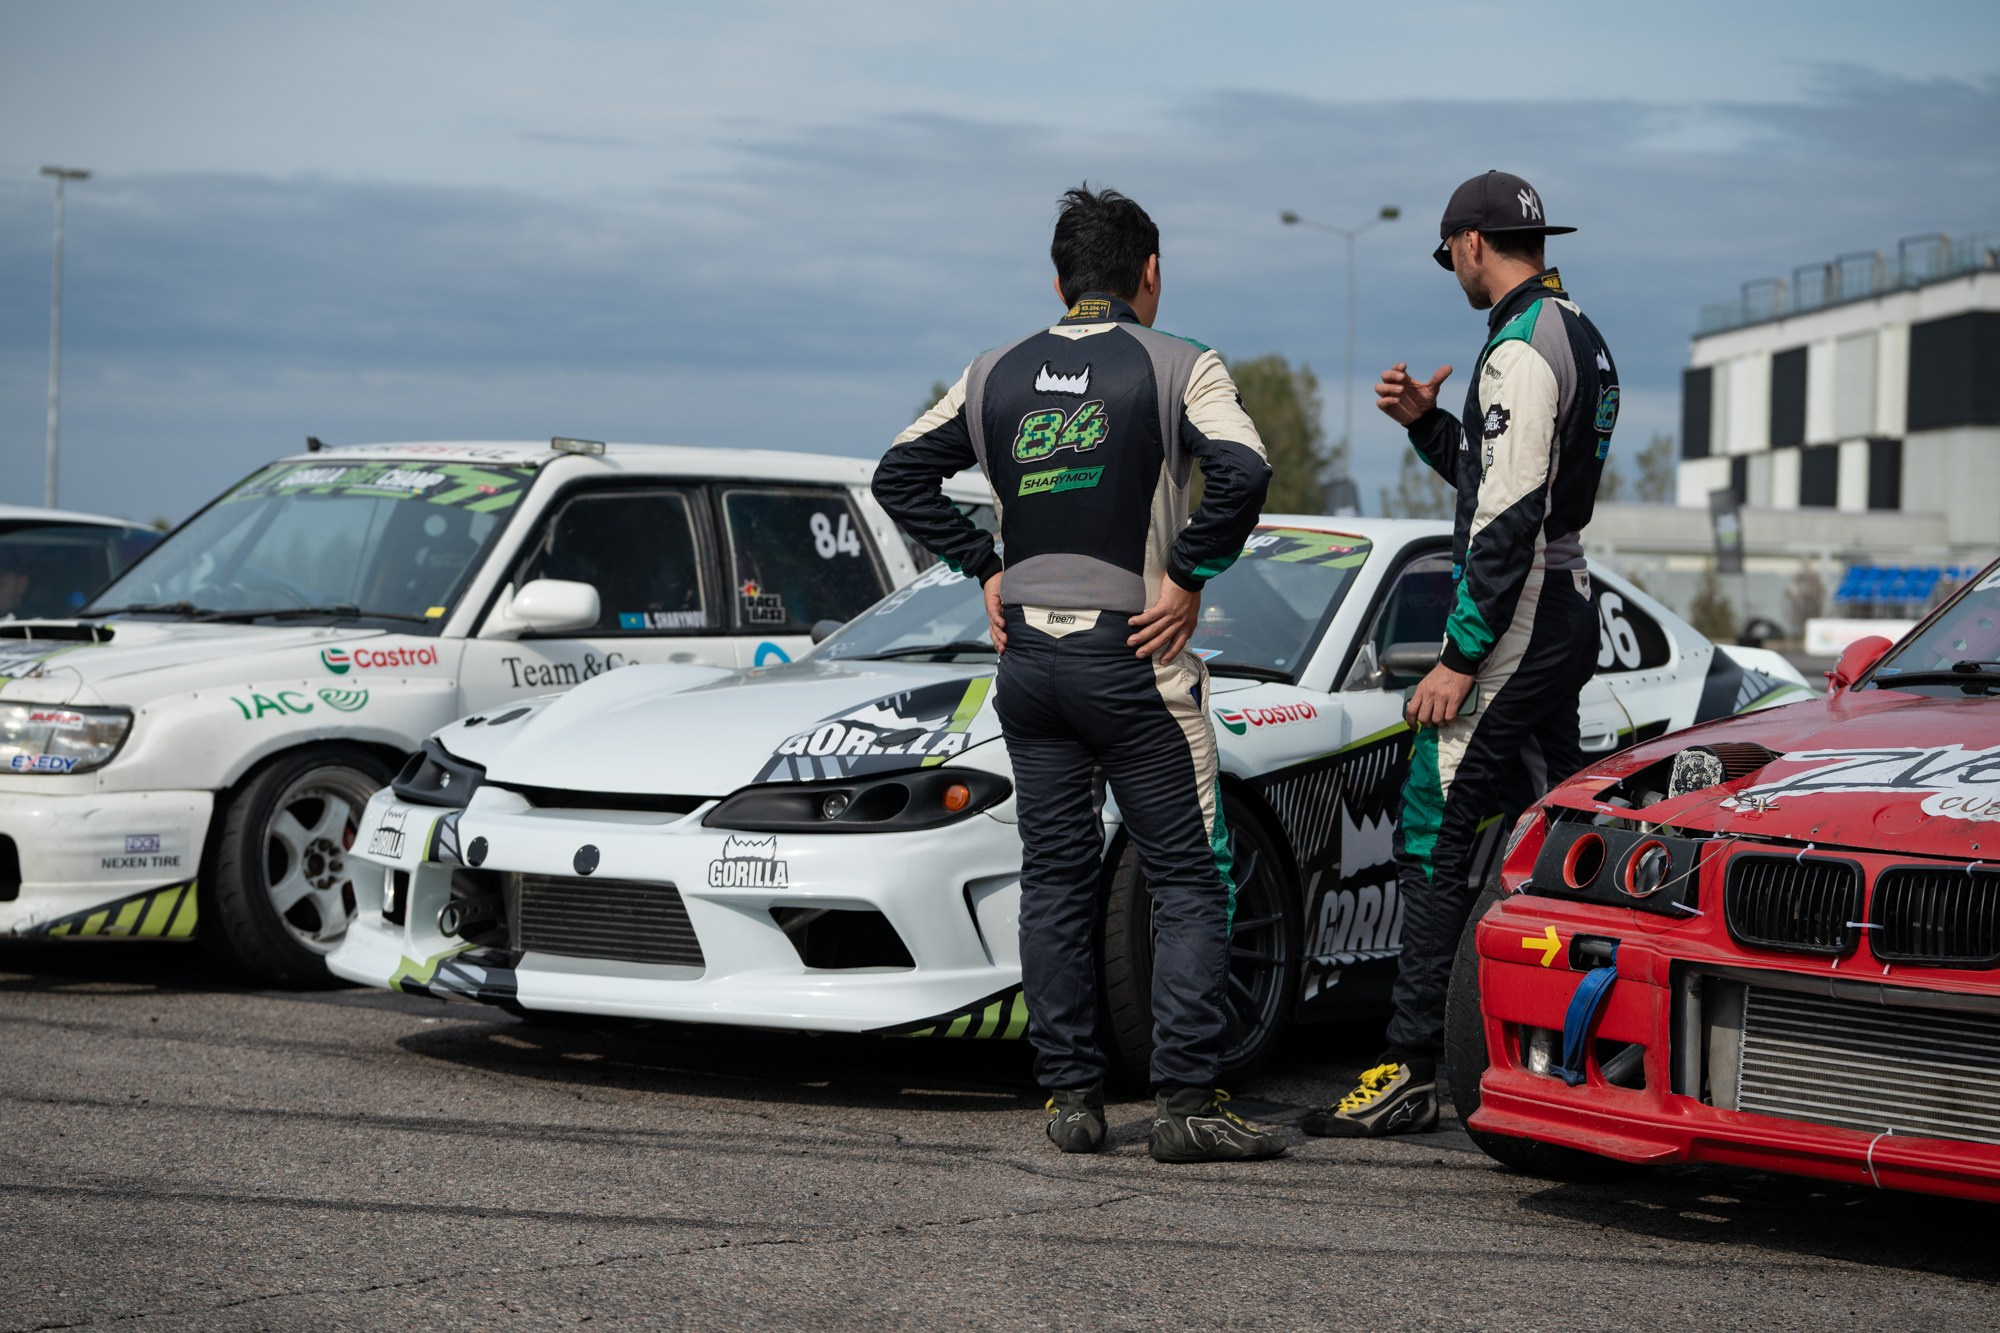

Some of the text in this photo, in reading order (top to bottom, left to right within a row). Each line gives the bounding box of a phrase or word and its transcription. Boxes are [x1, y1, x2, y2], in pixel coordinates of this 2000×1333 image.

[1014, 401, 1108, 462] 84
[1024, 471, 1098, 490] SHARYMOV
[810, 512, 860, 559] 84
[1047, 612, 1077, 625] freem
[354, 645, 438, 668] Castrol
[502, 652, 641, 687] Team&C
[1242, 701, 1318, 726] Castrol
[12, 755, 79, 771] EXEDY
[101, 855, 181, 869] NEXEN TIRE
[709, 860, 788, 888] GORILLA
[1313, 880, 1404, 965] GORIL
